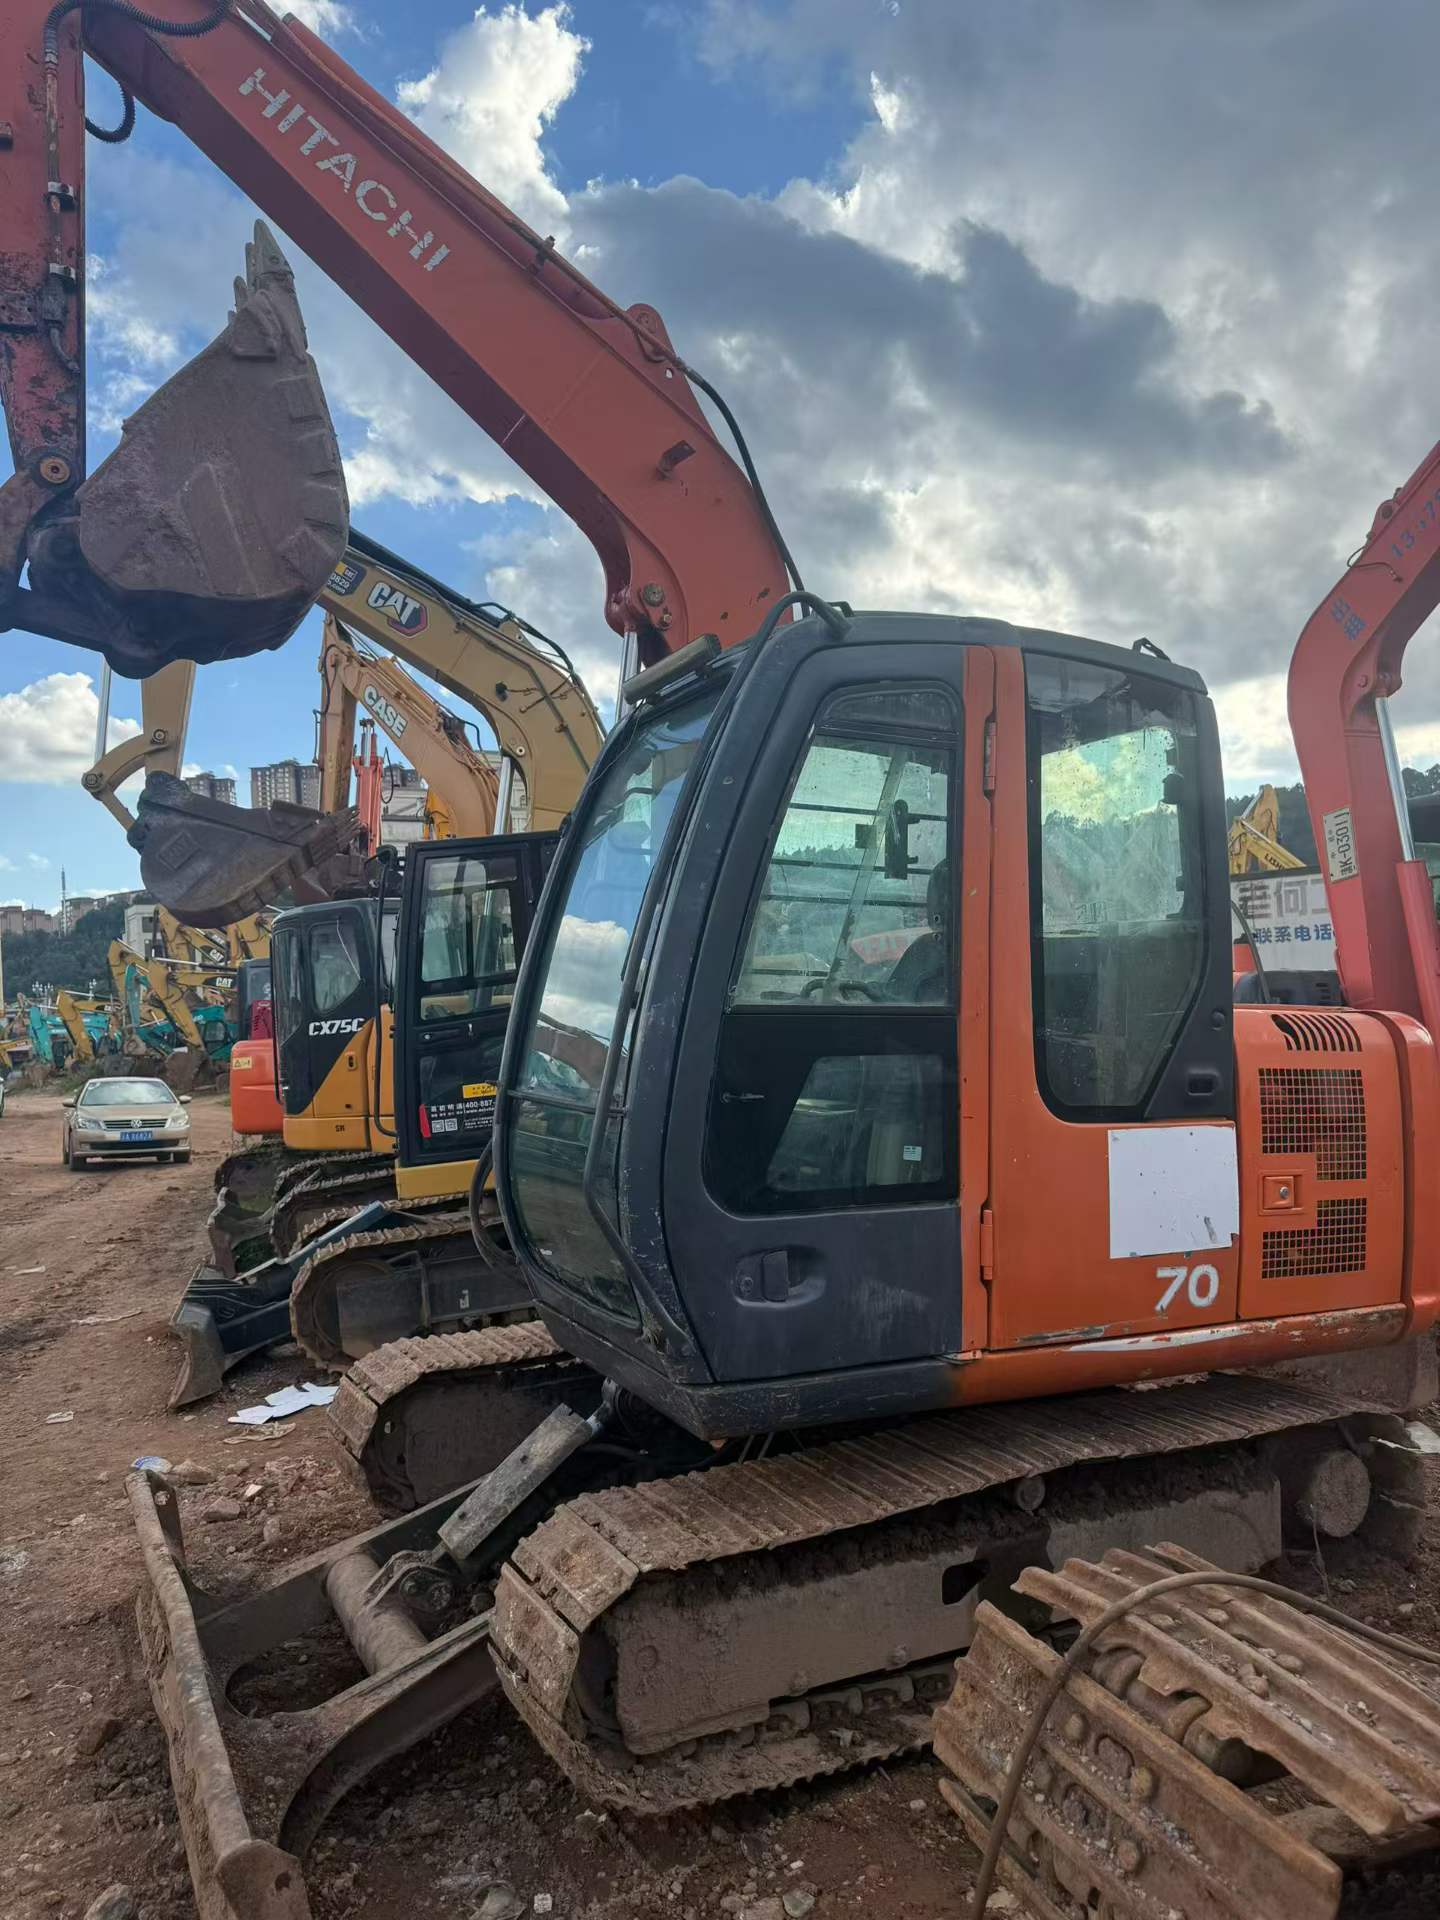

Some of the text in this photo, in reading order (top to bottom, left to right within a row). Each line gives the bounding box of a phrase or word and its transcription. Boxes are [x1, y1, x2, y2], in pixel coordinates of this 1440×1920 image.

[238, 68, 450, 272] HITACHI
[368, 582, 420, 625] CAT
[364, 685, 407, 738] CASE
[209, 949, 224, 962] CAT
[216, 977, 233, 988] CAT
[309, 1018, 364, 1035] CX75C
[1155, 1264, 1220, 1311] 70
